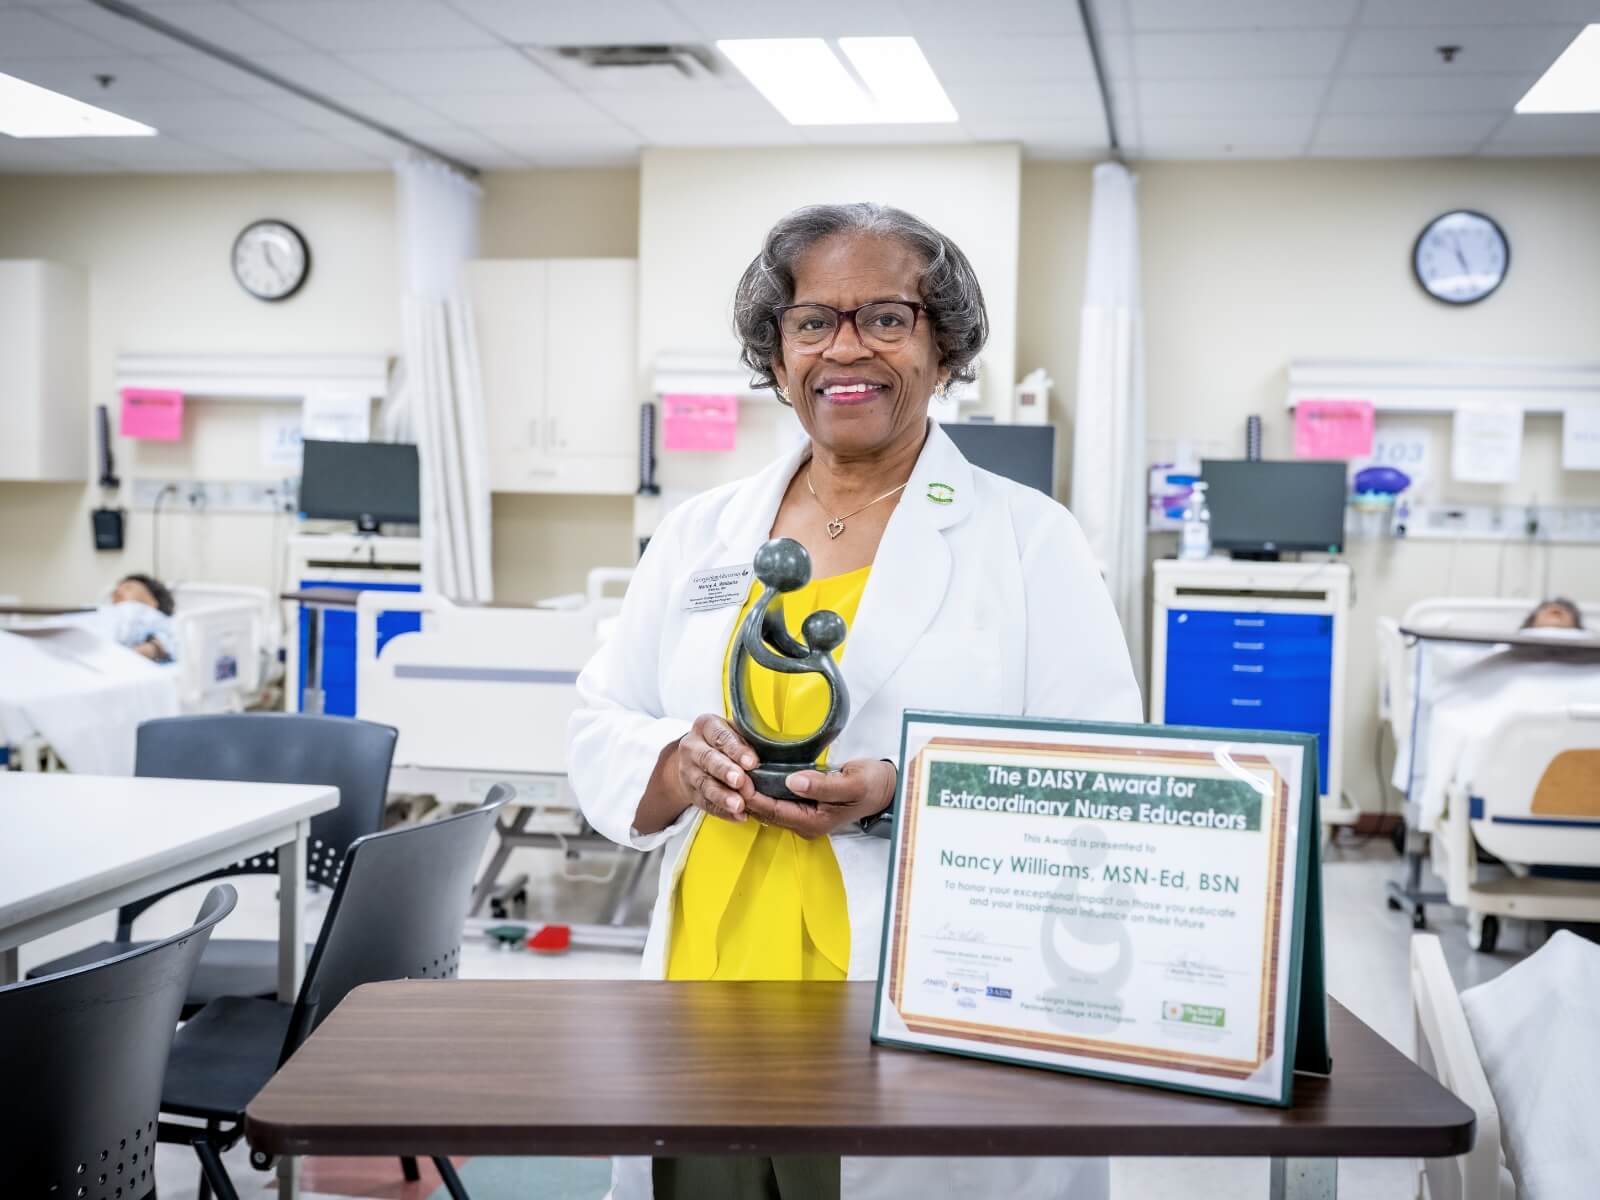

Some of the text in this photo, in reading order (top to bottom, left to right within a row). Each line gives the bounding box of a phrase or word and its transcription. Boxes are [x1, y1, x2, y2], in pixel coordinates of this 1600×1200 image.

[988, 767, 1195, 798] The DAISY Award for
[940, 790, 1246, 829] Extraordinary Nurse Educators
[1024, 833, 1156, 853] This Award is presented to
[941, 849, 1239, 893] Nancy Williams, MSN-Ed, BSN
[945, 881, 1236, 917] To honor your exceptional impact on those you educate
[970, 896, 988, 906] and
[992, 901, 1012, 912] your
[1016, 900, 1077, 916] inspirational
[1080, 907, 1127, 920] influence
[1131, 914, 1144, 922] on
[1148, 913, 1170, 925] their
